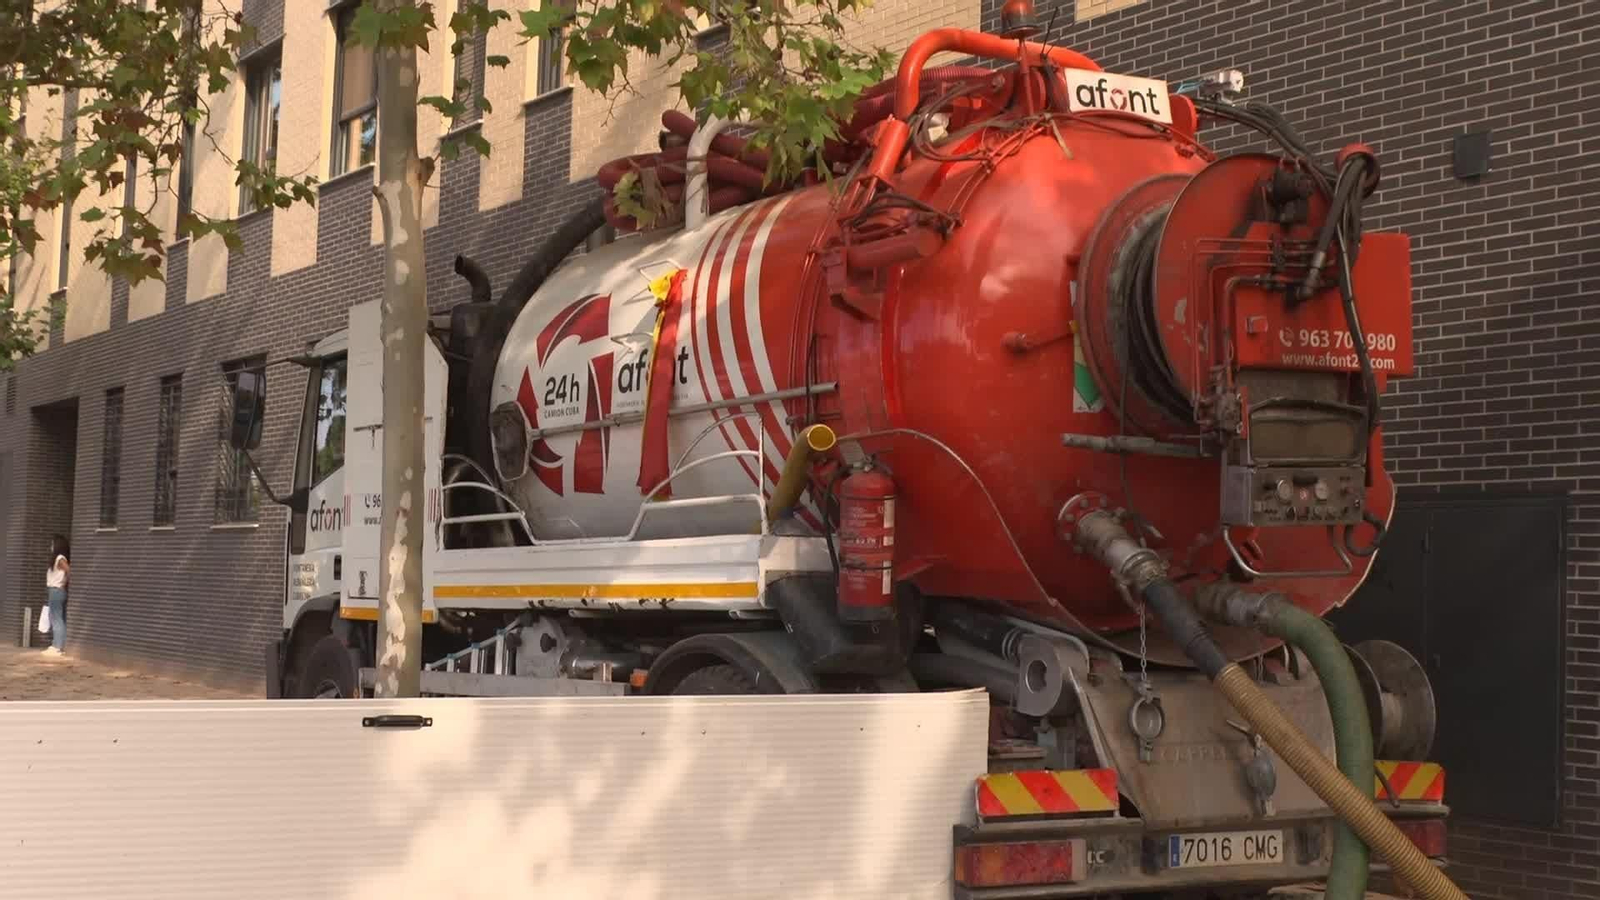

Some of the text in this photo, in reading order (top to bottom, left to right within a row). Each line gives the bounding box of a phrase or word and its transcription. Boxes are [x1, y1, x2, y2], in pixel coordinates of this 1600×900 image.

[1076, 79, 1160, 115] afont
[1299, 329, 1396, 351] 963 70 980
[618, 346, 689, 394] aft
[1282, 352, 1395, 369] www.afont2com
[544, 373, 580, 406] 24h
[544, 406, 580, 419] CAMION CUBA
[310, 500, 344, 532] afon
[372, 494, 381, 508] 96
[1184, 834, 1278, 864] 7016 CMG
